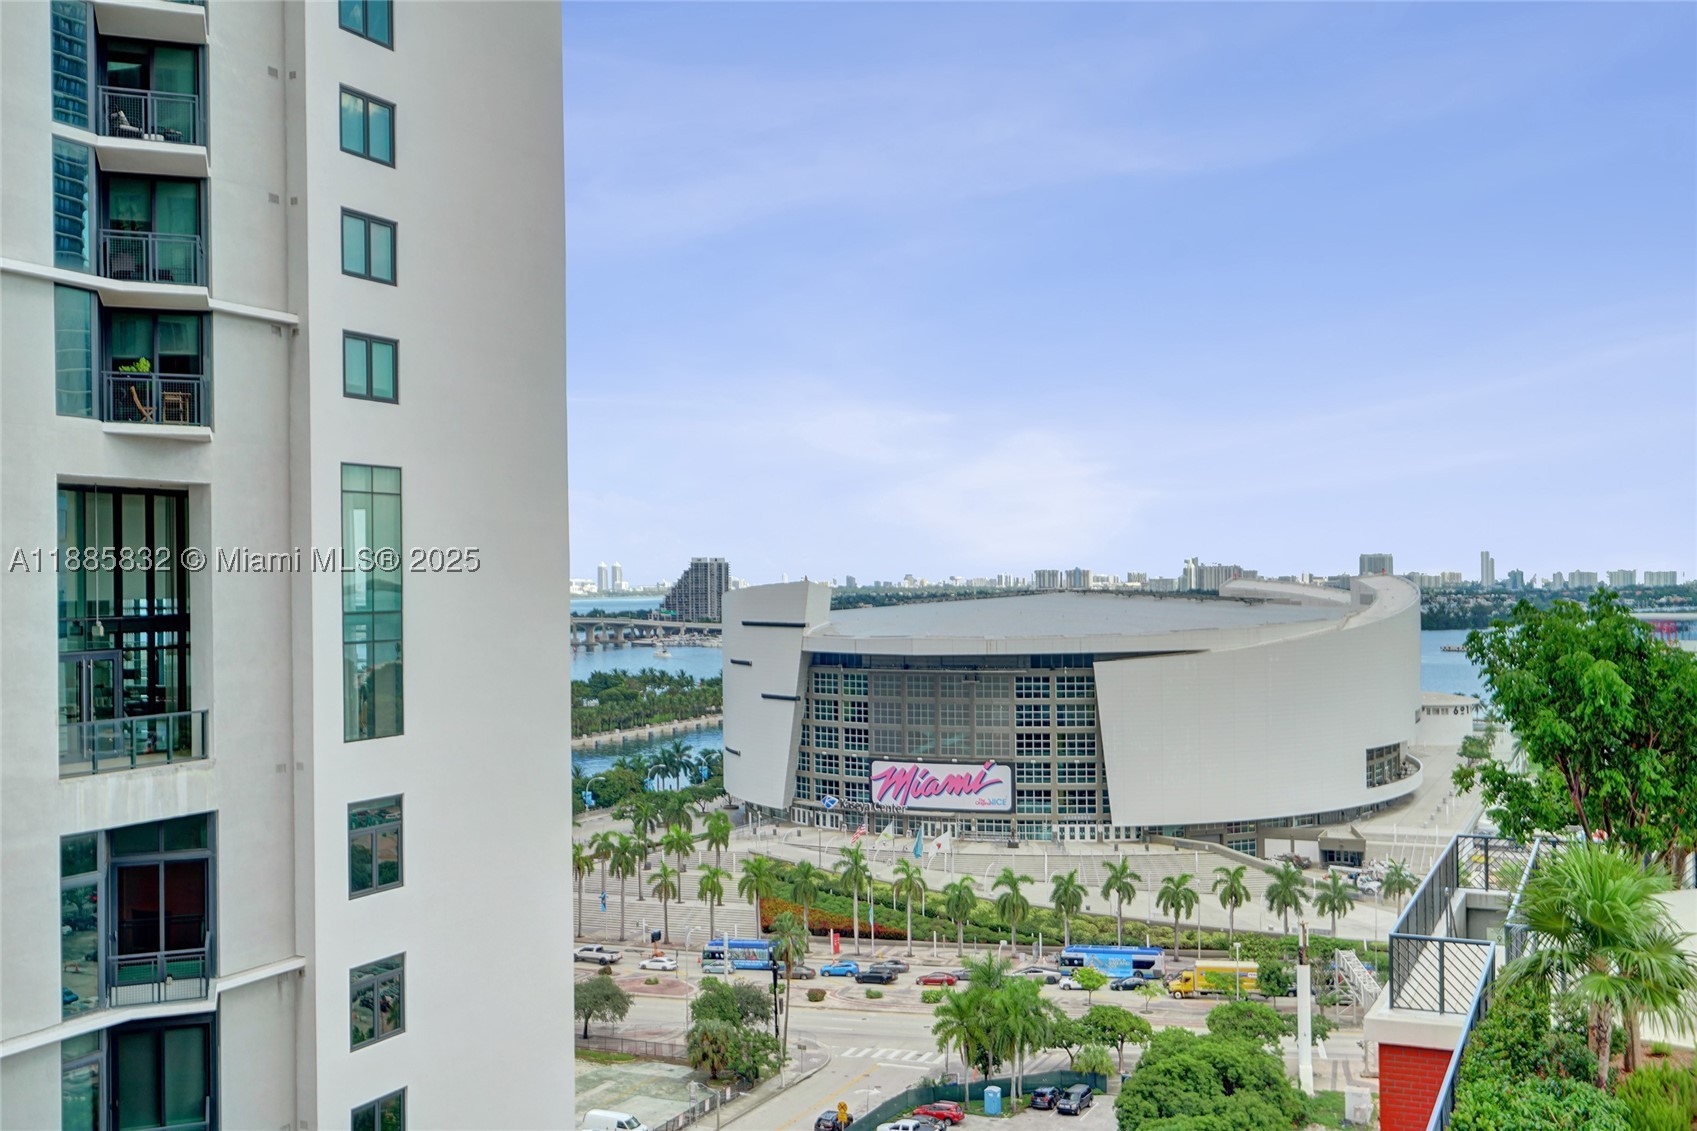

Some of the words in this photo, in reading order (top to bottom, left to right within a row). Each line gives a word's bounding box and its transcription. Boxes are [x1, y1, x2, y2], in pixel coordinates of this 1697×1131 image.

[1453, 705, 1469, 715] 601
[870, 760, 1003, 806] Miami
[840, 798, 872, 812] Kaseya
[874, 802, 906, 814] Center
